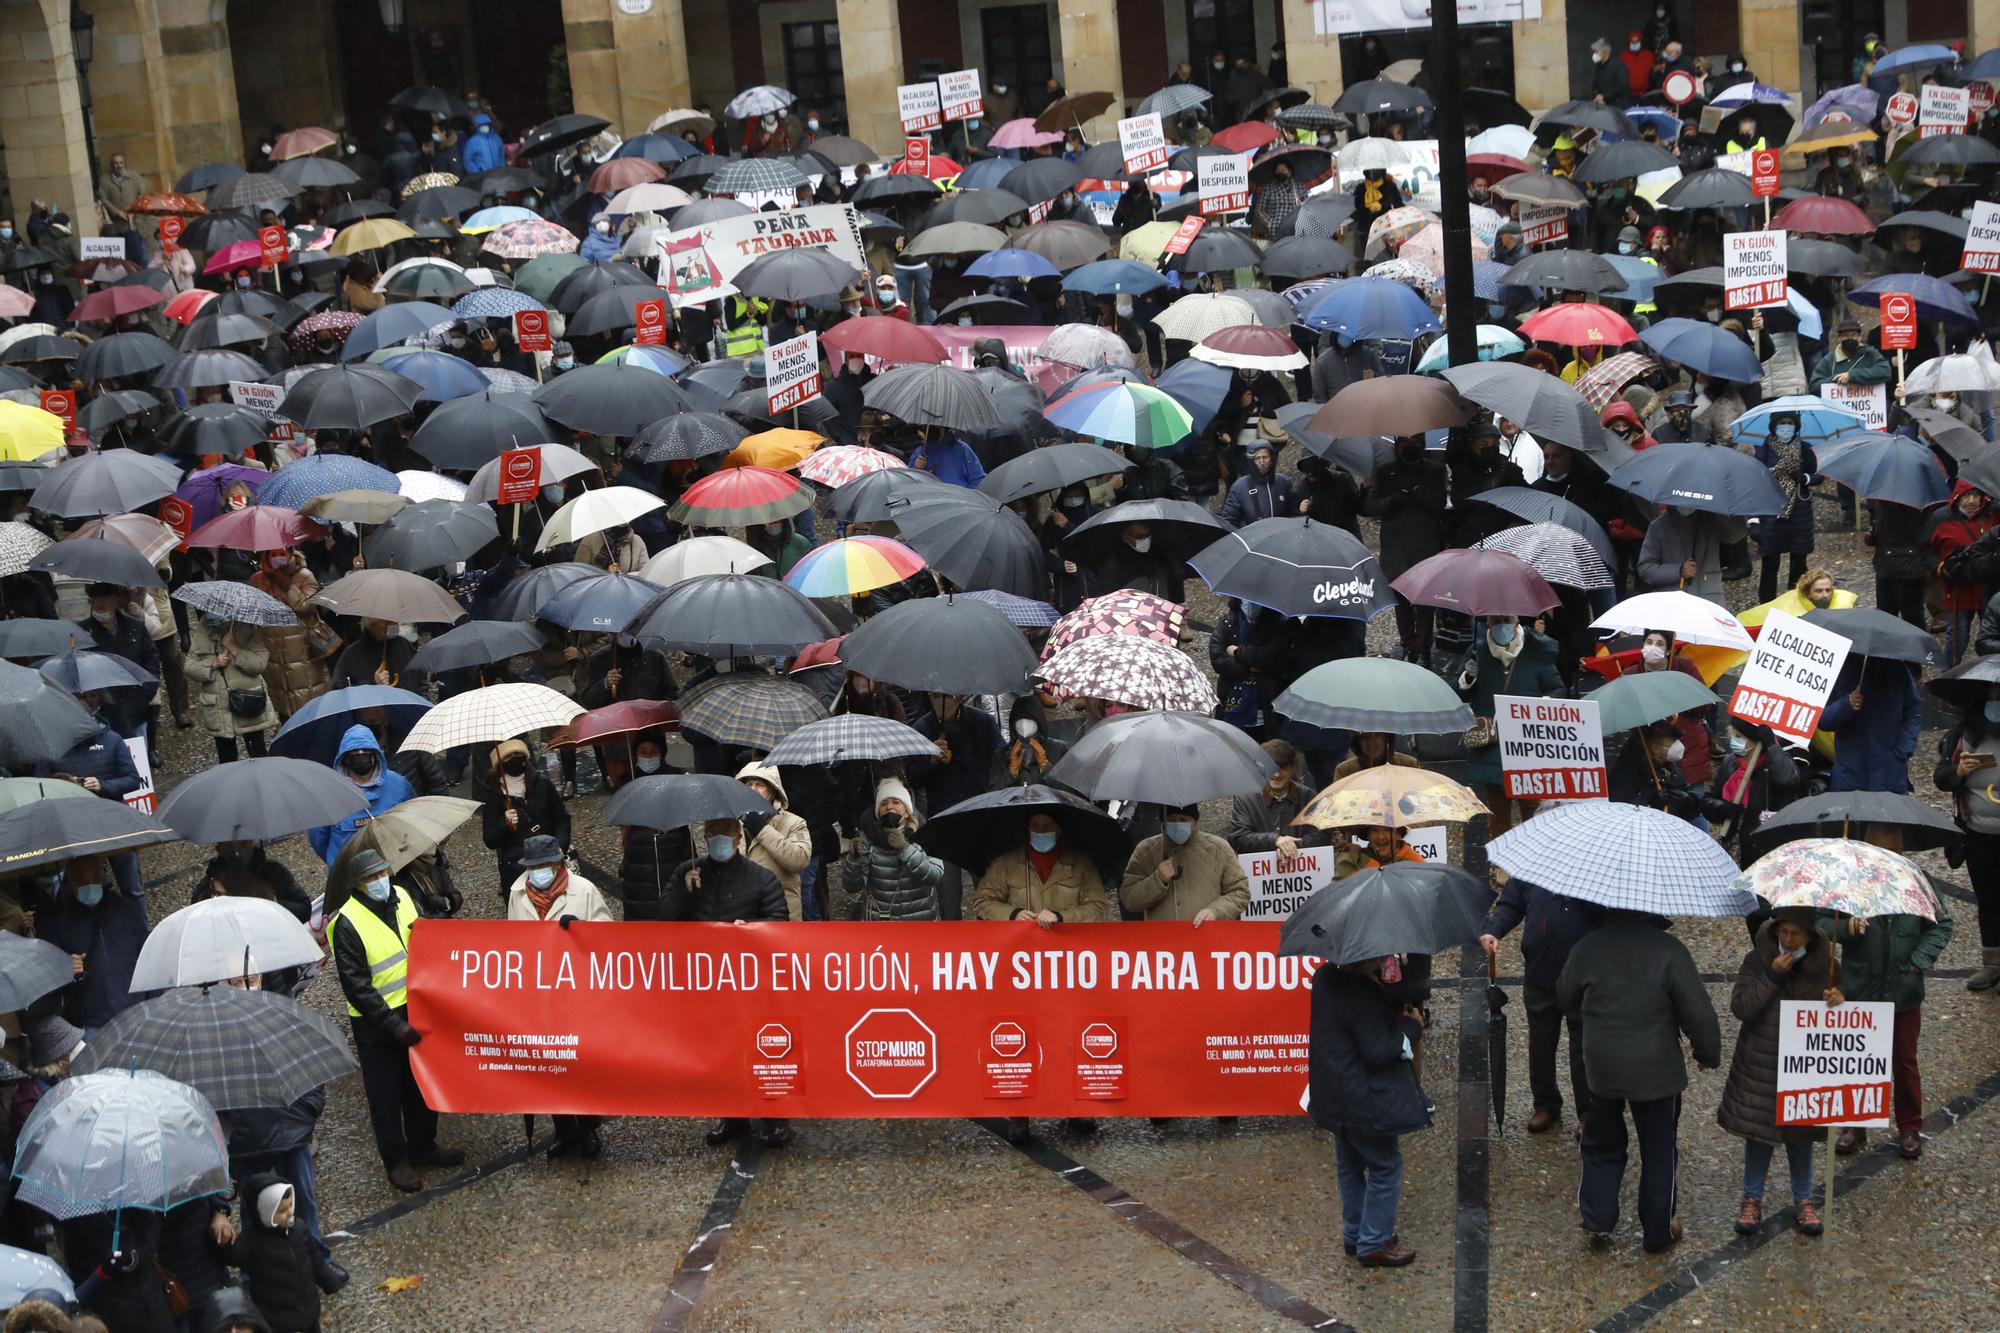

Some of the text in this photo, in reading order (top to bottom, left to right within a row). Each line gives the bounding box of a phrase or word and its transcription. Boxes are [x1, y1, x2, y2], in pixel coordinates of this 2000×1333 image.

[903, 90, 934, 100] ALCALDESA
[944, 90, 979, 101] IMPOSICIÓN
[950, 83, 971, 92] MENOS
[1929, 90, 1938, 98] EN
[902, 103, 915, 111] VETE
[923, 101, 937, 109] CASA
[946, 103, 968, 120] BASTA
[1932, 100, 1958, 111] MENOS
[904, 116, 926, 133] BASTA
[1922, 110, 1966, 122] IMPOSICIÓN
[1125, 123, 1134, 131] EN
[1131, 128, 1154, 140] MENOS
[1124, 136, 1163, 152] IMPOSICIÓN
[1128, 154, 1152, 174] BASTA
[1211, 161, 1235, 174] ¡GIJÓN
[1201, 176, 1246, 187] DESPIERTA!
[1202, 196, 1230, 214] BASTA
[753, 212, 811, 234] PEÑA
[1523, 224, 1549, 245] BASTA
[1733, 238, 1745, 250] EN
[1740, 250, 1772, 264] MENOS
[1964, 253, 2000, 270] BASTA
[1728, 262, 1784, 279] IMPOSICIÓN
[1729, 281, 1784, 309] BASTA YA!
[773, 339, 810, 361] EN GIJÓN,
[779, 353, 806, 371] MENOS
[769, 360, 817, 387] IMPOSICIÓN
[238, 386, 249, 396] EN
[772, 377, 818, 413] BASTA YA!
[1831, 388, 1843, 400] EN
[246, 398, 275, 409] MENOS
[1842, 400, 1871, 412] ENOS
[1672, 489, 1714, 501] INESIS
[1768, 628, 1835, 668] ALCALDESA
[1755, 649, 1828, 694] VETE A CASA
[1510, 704, 1585, 726] EN GIJÓN,
[1733, 689, 1817, 733] BASTA YA!
[1522, 723, 1578, 742] MENOS
[1505, 741, 1600, 762] IMPOSICIÓN
[1510, 771, 1601, 796] BASTA YA!
[1253, 853, 1321, 877] EN GIJÓN,
[1262, 876, 1312, 896] MENOS
[536, 951, 576, 990] LA
[590, 952, 759, 991] MOVILIDAD
[772, 953, 810, 991] EN
[824, 945, 919, 995] GIJÓN,
[933, 952, 999, 991] HAY
[1012, 951, 1098, 990] SITIO
[1111, 952, 1200, 990] PARA
[1796, 1006, 1878, 1032] EN GIJÓN,
[464, 1033, 579, 1046] CONTRA LA PEATONALIZACIÓN
[1206, 1036, 1238, 1046] CONTRA
[1240, 1036, 1251, 1046] LA
[1806, 1033, 1866, 1052] MENOS
[465, 1046, 479, 1056] DEL
[481, 1047, 501, 1057] MURO
[502, 1048, 508, 1057] Y
[509, 1049, 531, 1059] AVDA.
[532, 1049, 542, 1059] EL
[856, 1041, 926, 1058] STOPMURO
[1206, 1048, 1309, 1061] DEL MURO Y AVDA. EL MOLI
[479, 1063, 488, 1071] La
[489, 1063, 513, 1071] Ronda
[515, 1064, 537, 1072] Norte
[548, 1065, 568, 1075] Gijón
[857, 1059, 926, 1067] PLATAFORMA CIUDADANA
[1232, 1066, 1257, 1074] Ronda
[1283, 1065, 1292, 1073] de
[1294, 1064, 1309, 1074] Gijó
[1784, 1053, 1887, 1076] IMPOSICIÓN
[1783, 1087, 1884, 1122] BASTA YA!
